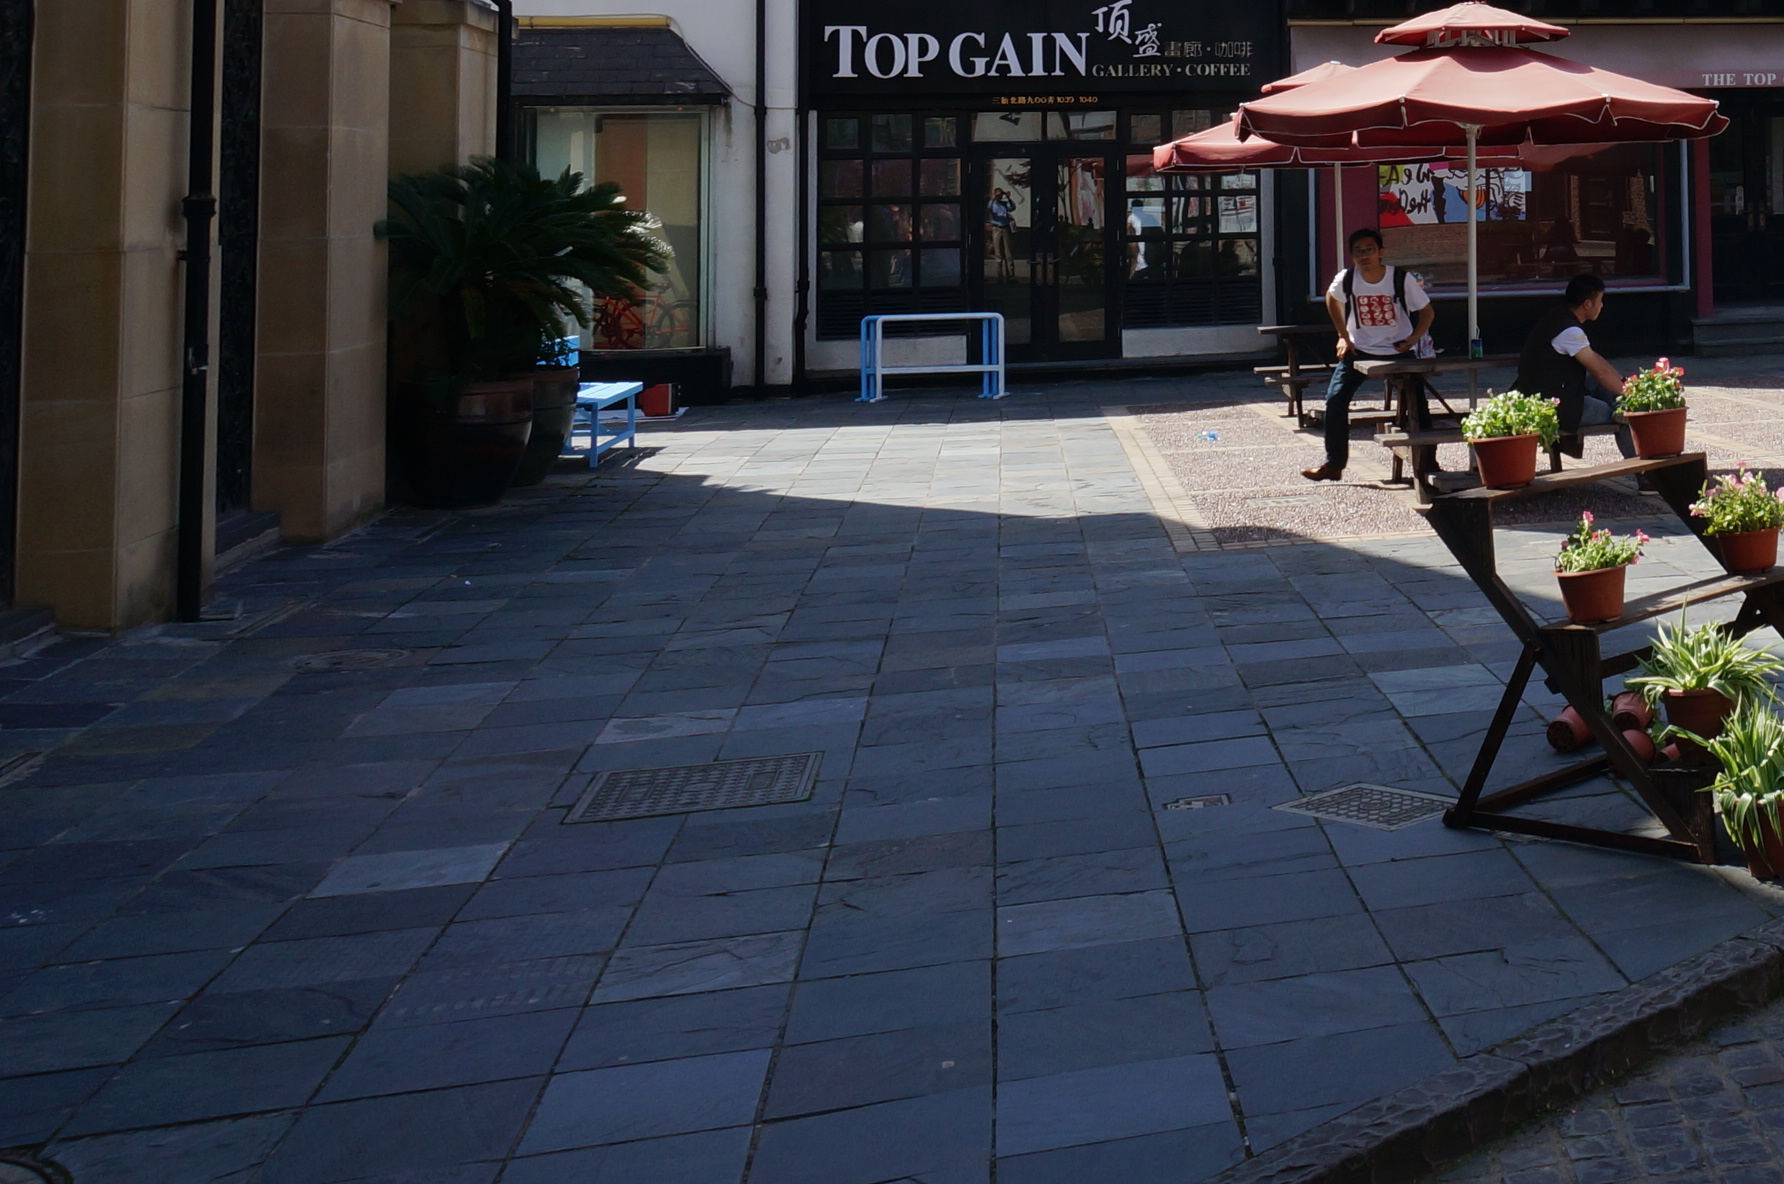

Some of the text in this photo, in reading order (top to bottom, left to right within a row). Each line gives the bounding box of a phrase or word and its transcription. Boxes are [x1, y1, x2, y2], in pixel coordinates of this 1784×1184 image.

[824, 25, 1090, 79] TOP GAIN
[1092, 63, 1251, 77] GALLERY COFFEE
[1702, 73, 1736, 86] THE
[1743, 73, 1777, 86] TOP
